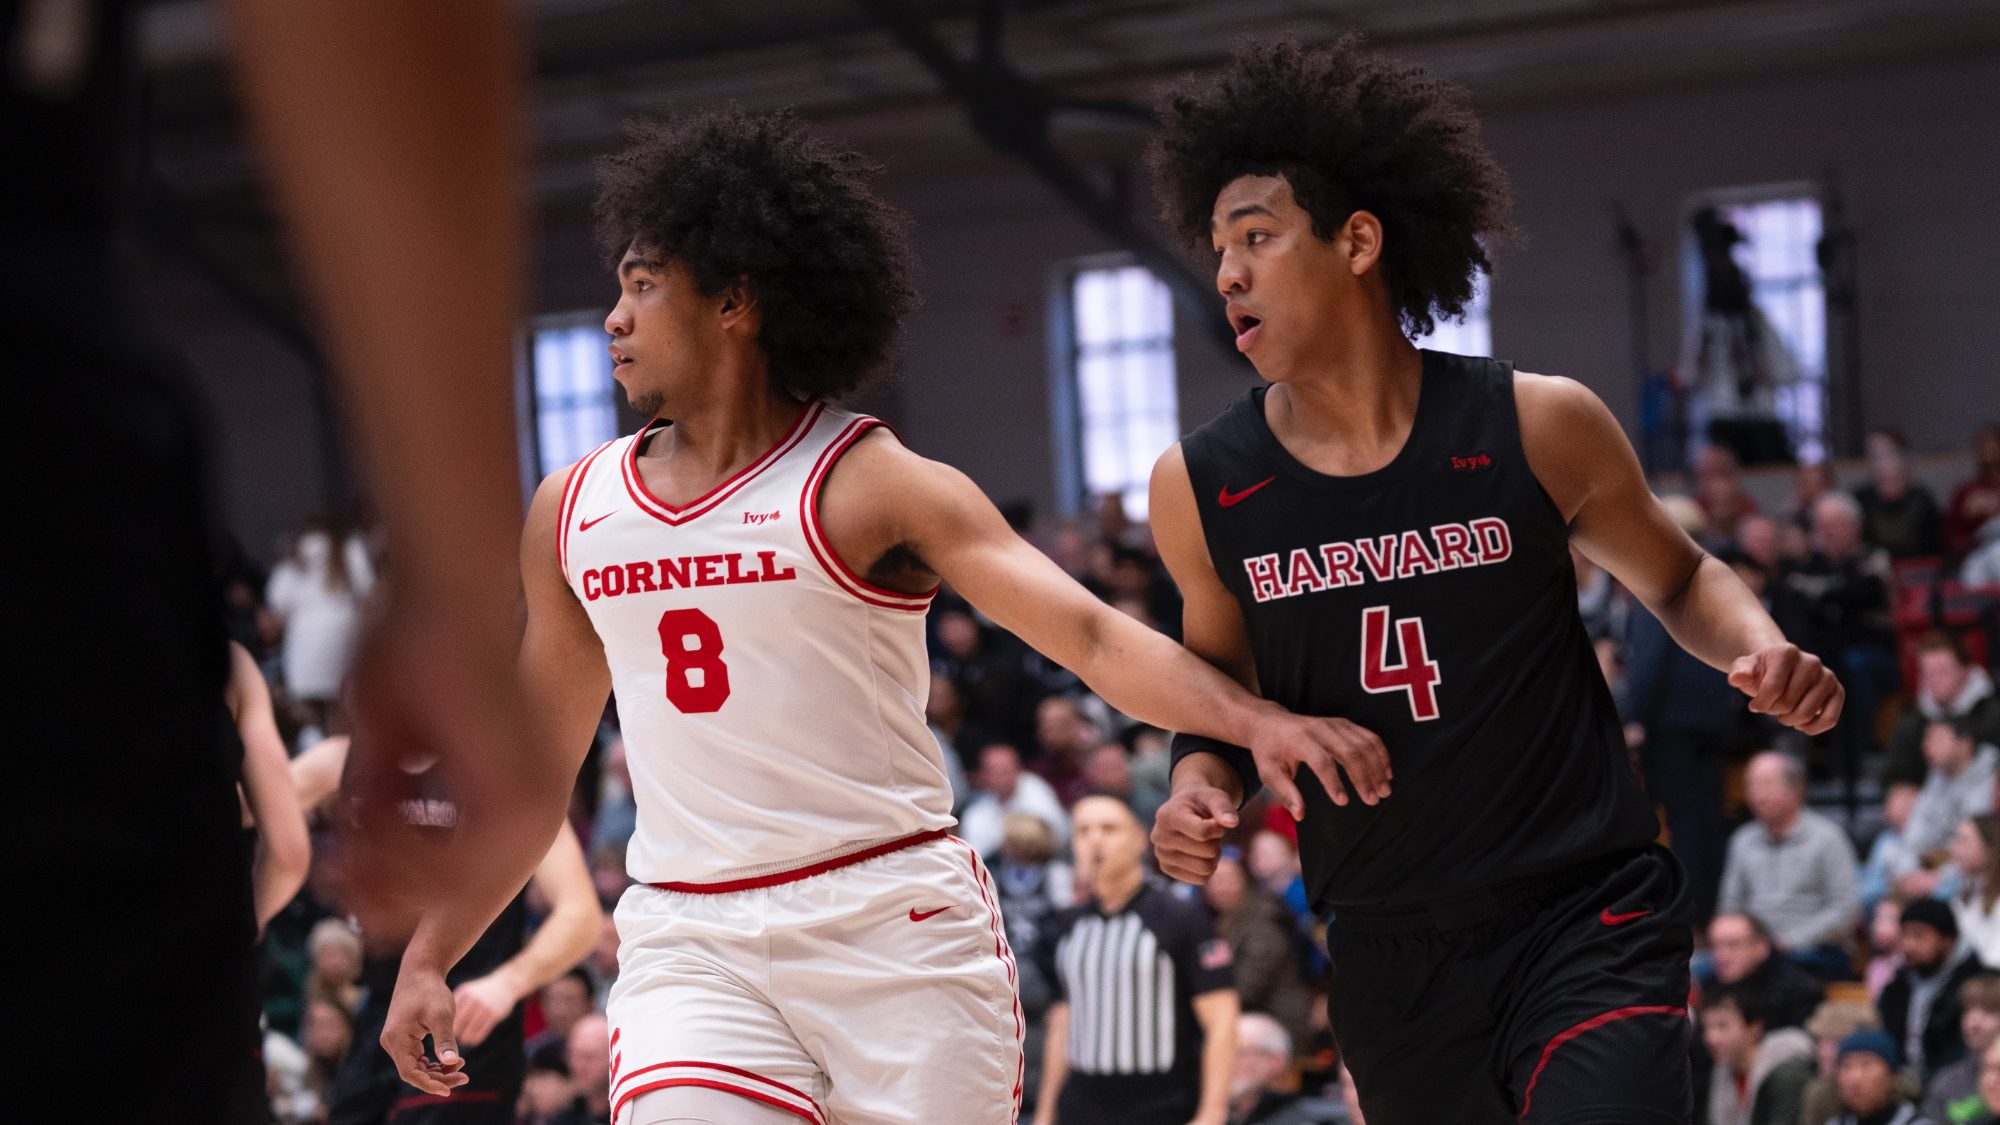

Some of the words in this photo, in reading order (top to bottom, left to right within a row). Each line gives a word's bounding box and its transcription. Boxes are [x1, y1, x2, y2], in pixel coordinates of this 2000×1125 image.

[1451, 456, 1477, 470] Ivy
[742, 511, 769, 526] Ivy
[582, 550, 797, 602] CORNELL
[1243, 516, 1513, 603] HARVARD
[657, 607, 731, 715] 8
[1359, 604, 1442, 722] 4
